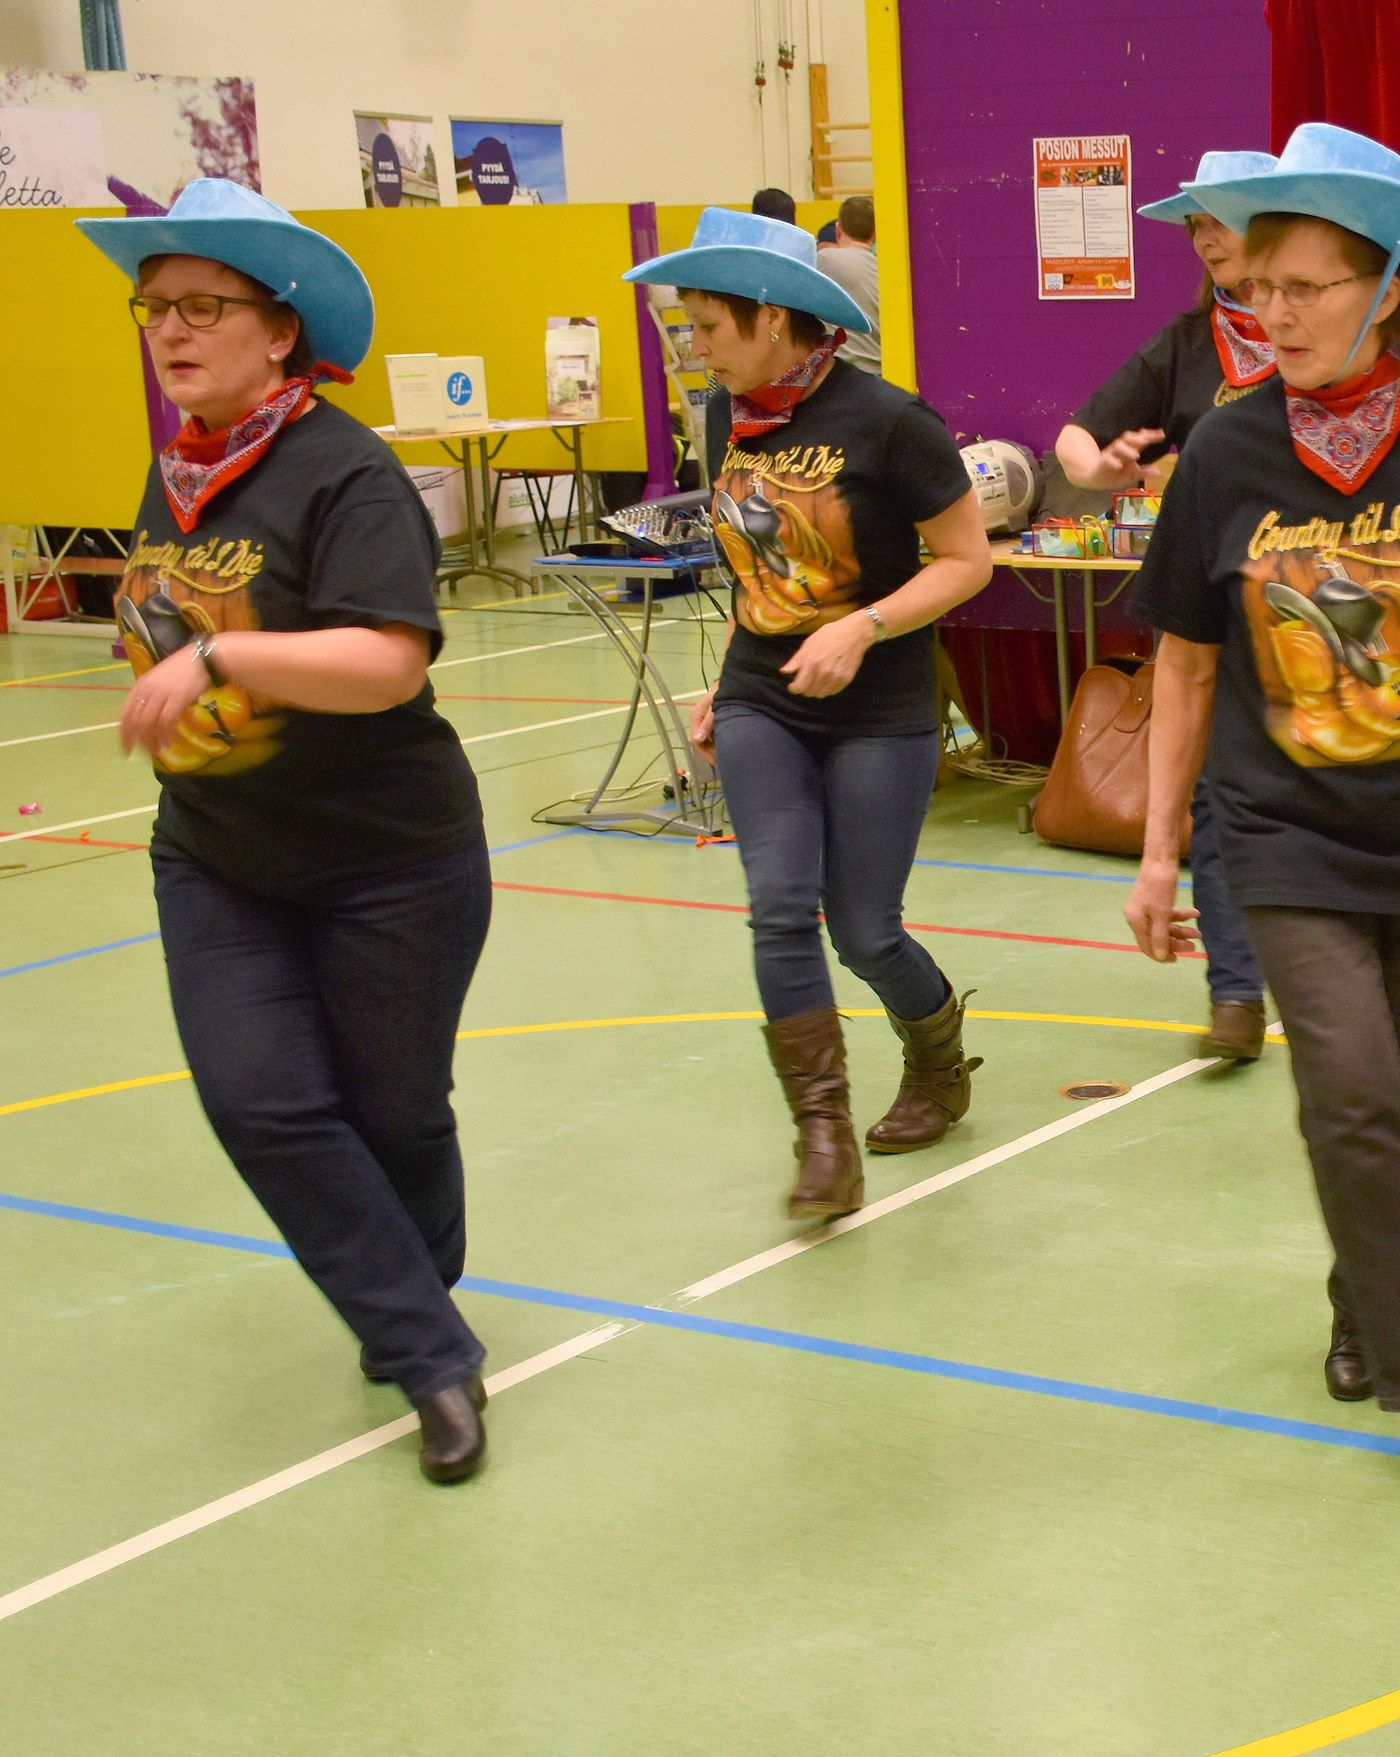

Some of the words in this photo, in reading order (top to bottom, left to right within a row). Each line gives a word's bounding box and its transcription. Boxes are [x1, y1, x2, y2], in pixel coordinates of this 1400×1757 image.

[1039, 140, 1080, 160] POSION
[1082, 138, 1125, 159] MESSUT
[804, 445, 846, 479] Die
[1247, 509, 1344, 561] Country
[217, 538, 264, 578] Die
